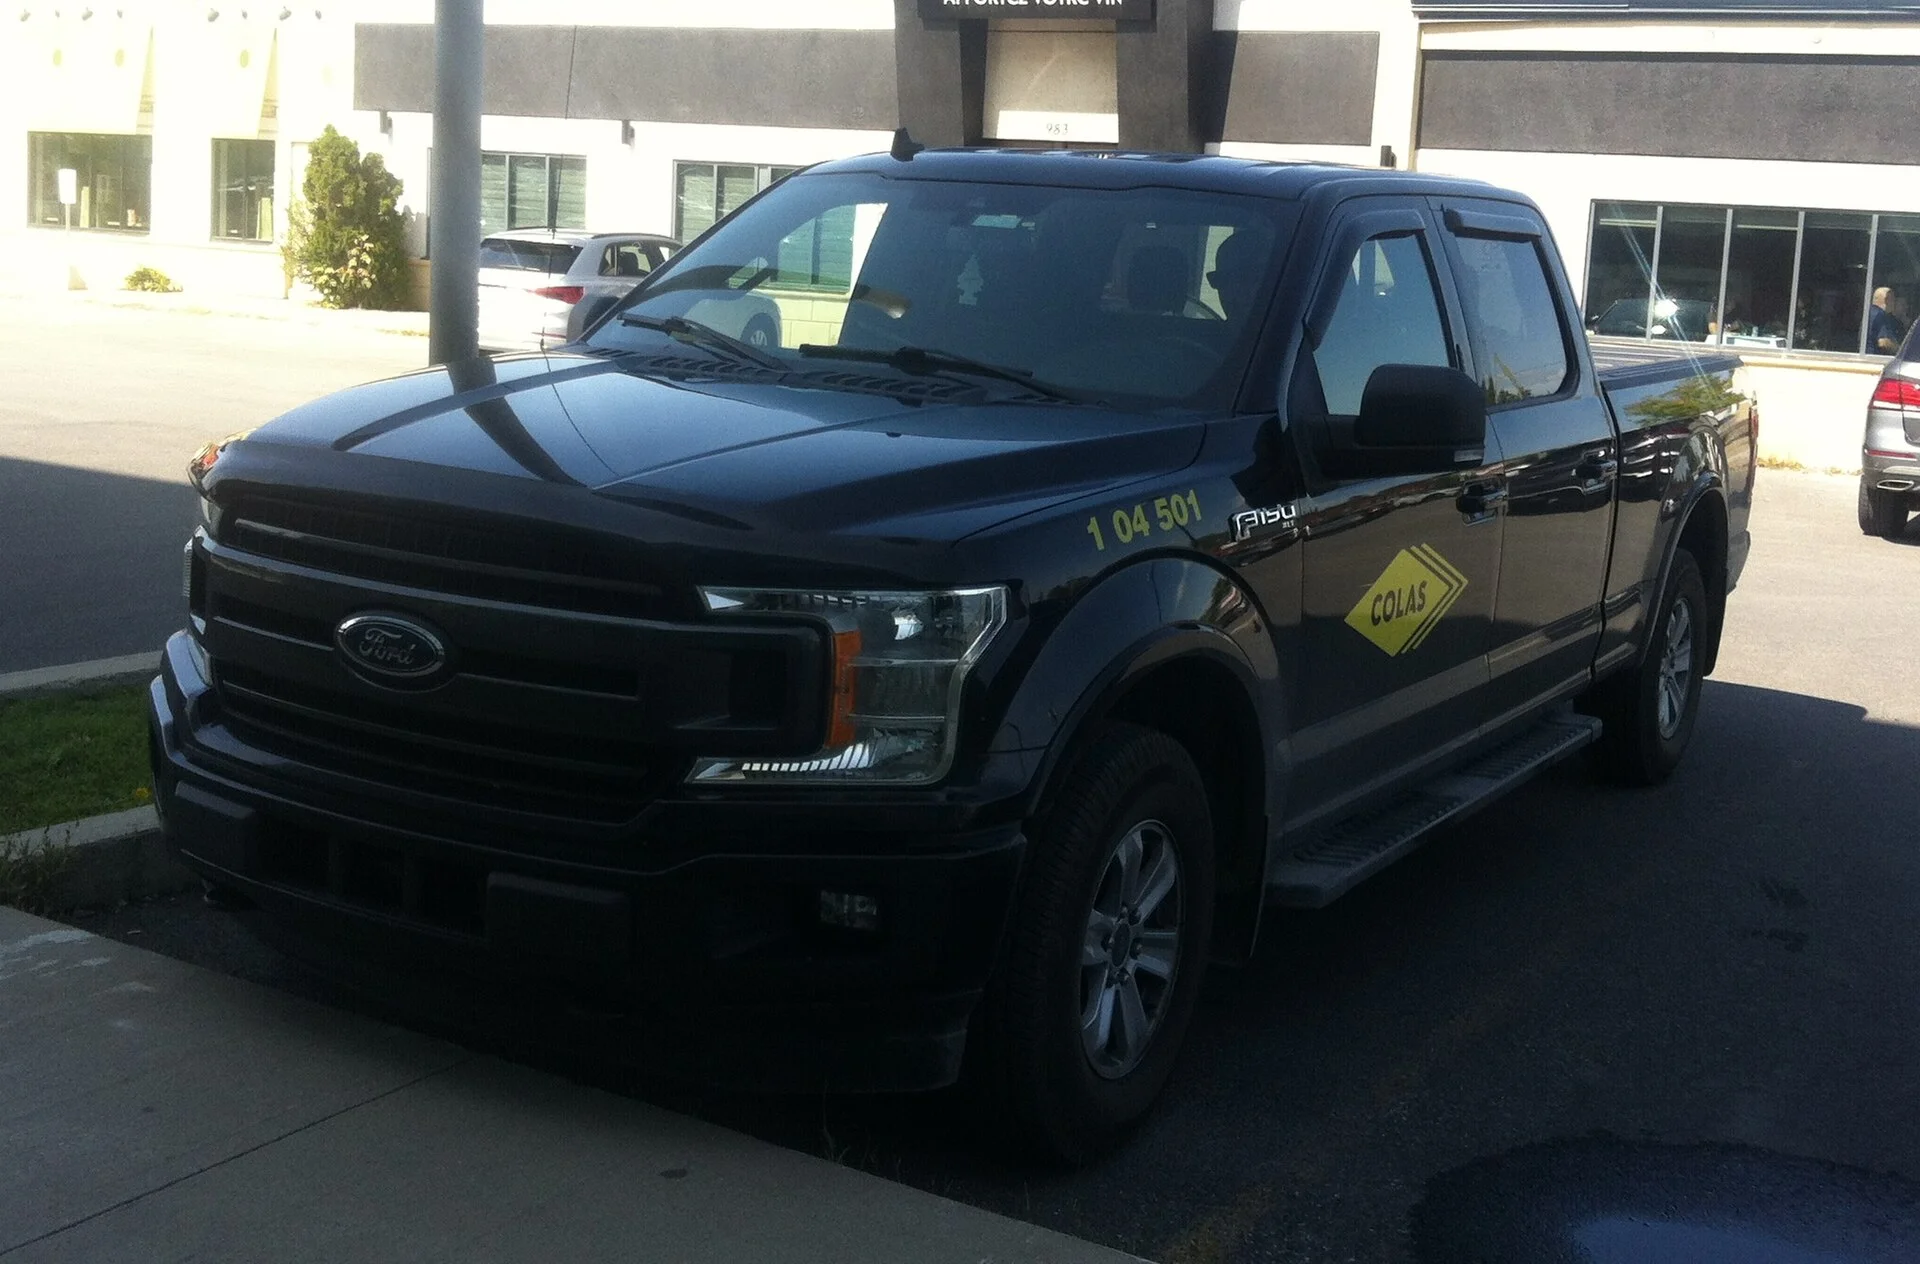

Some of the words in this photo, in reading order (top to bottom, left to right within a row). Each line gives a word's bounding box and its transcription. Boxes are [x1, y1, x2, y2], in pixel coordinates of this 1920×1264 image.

[1046, 123, 1069, 135] 983
[1087, 516, 1105, 551] 1
[1112, 505, 1150, 543] 04
[1154, 489, 1202, 530] 501
[1371, 580, 1428, 626] COLAS
[360, 628, 416, 665] Ford
